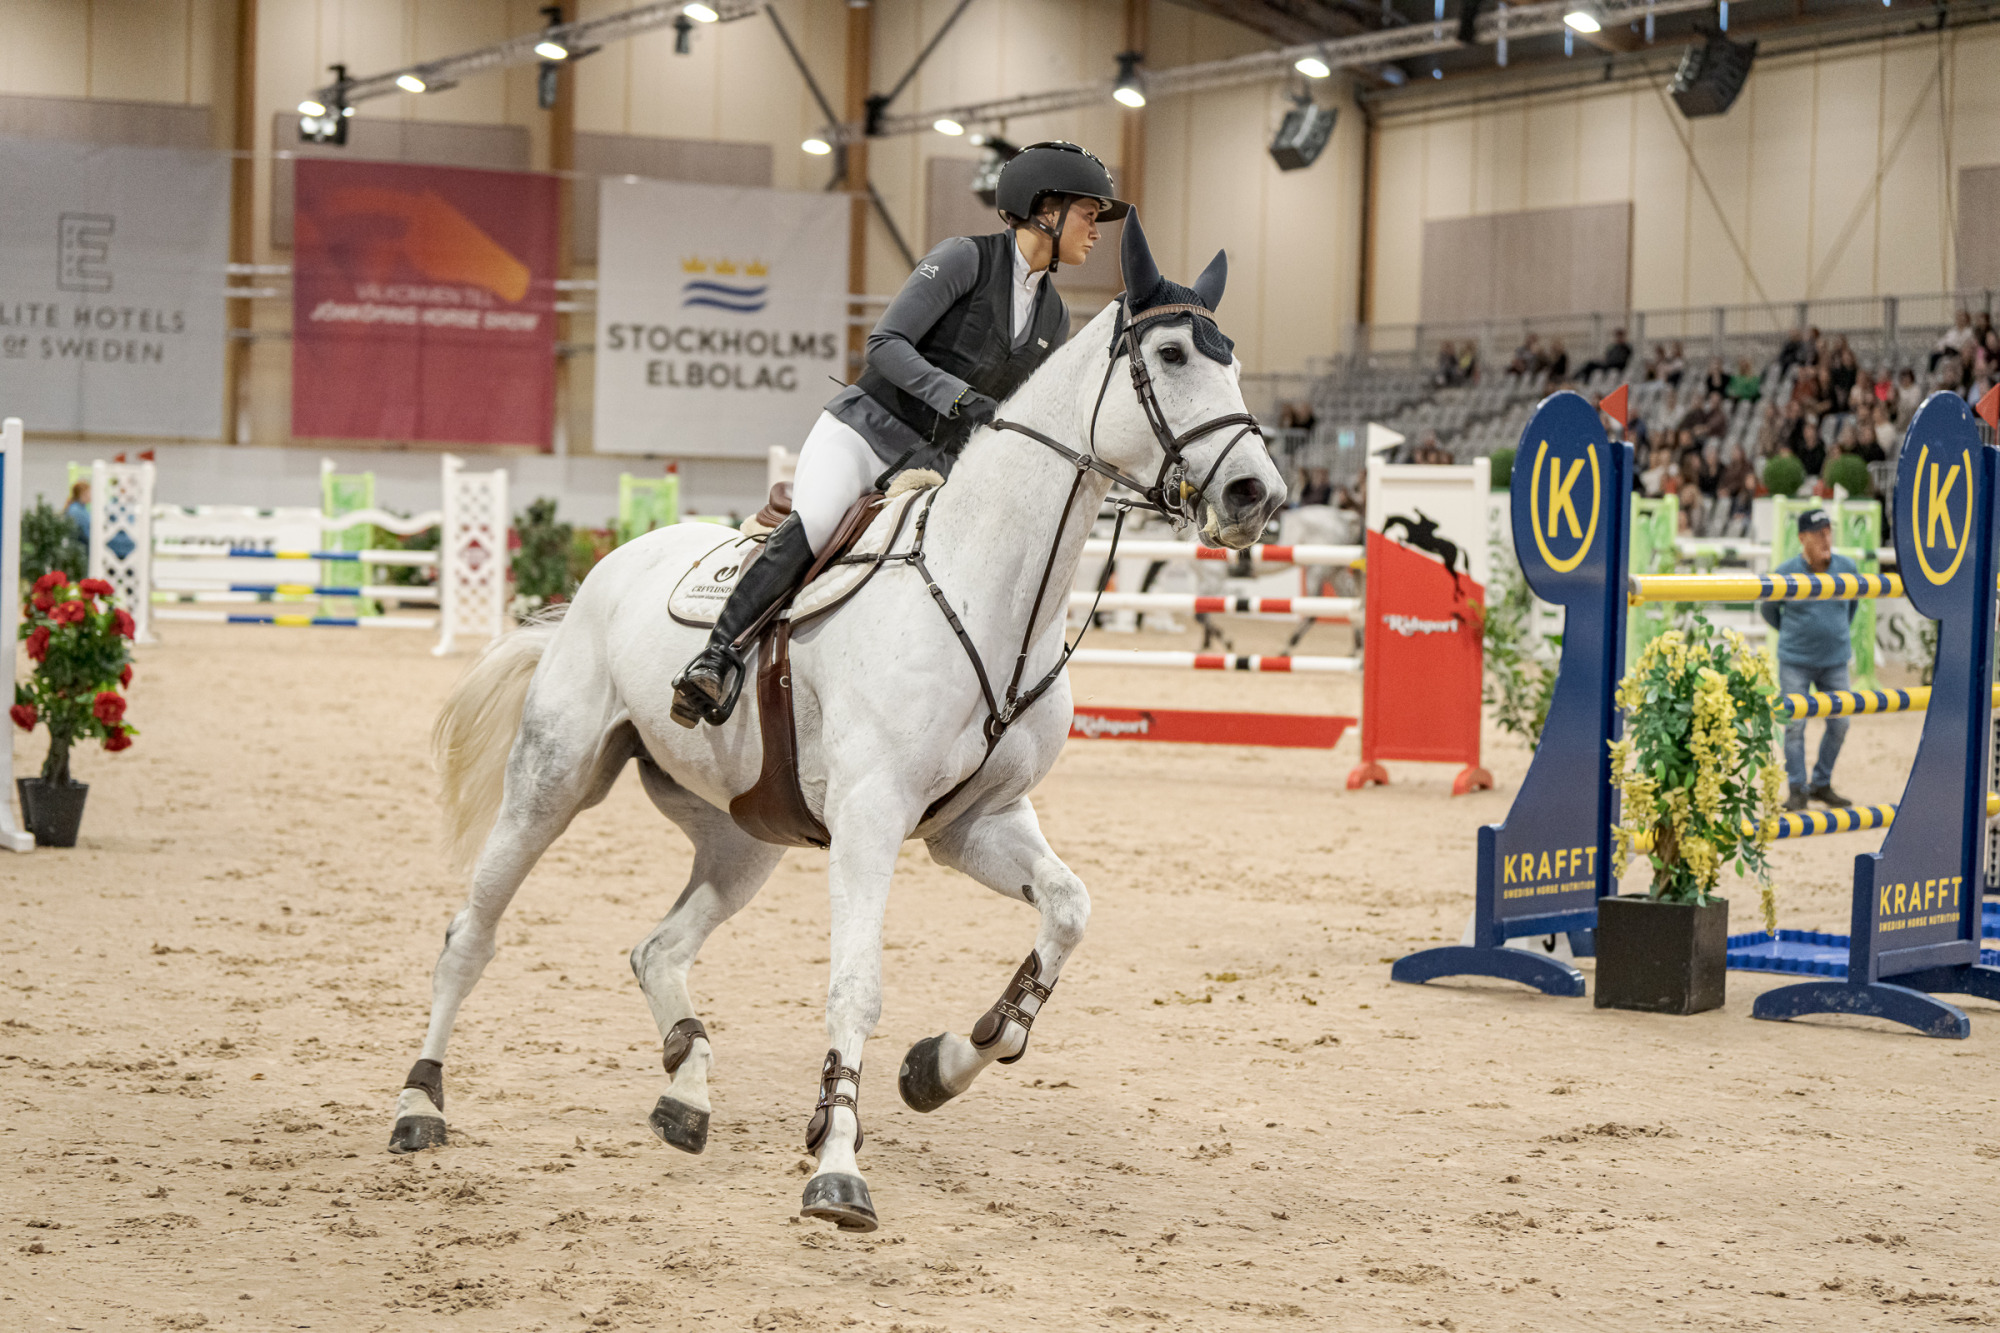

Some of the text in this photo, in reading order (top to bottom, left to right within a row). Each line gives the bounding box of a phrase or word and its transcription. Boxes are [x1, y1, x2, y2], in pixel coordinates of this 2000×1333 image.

[74, 305, 186, 334] HOTELS
[41, 335, 163, 363] SWEDEN
[607, 323, 838, 360] STOCKHOLMS
[647, 360, 798, 392] ELBOLAG
[1547, 457, 1586, 540] K
[1926, 463, 1961, 550] K
[1504, 846, 1597, 884] KRAFFT
[1536, 884, 1559, 895] HORSE
[1879, 876, 1963, 916] KRAFFT
[1907, 916, 1928, 928] HORSE
